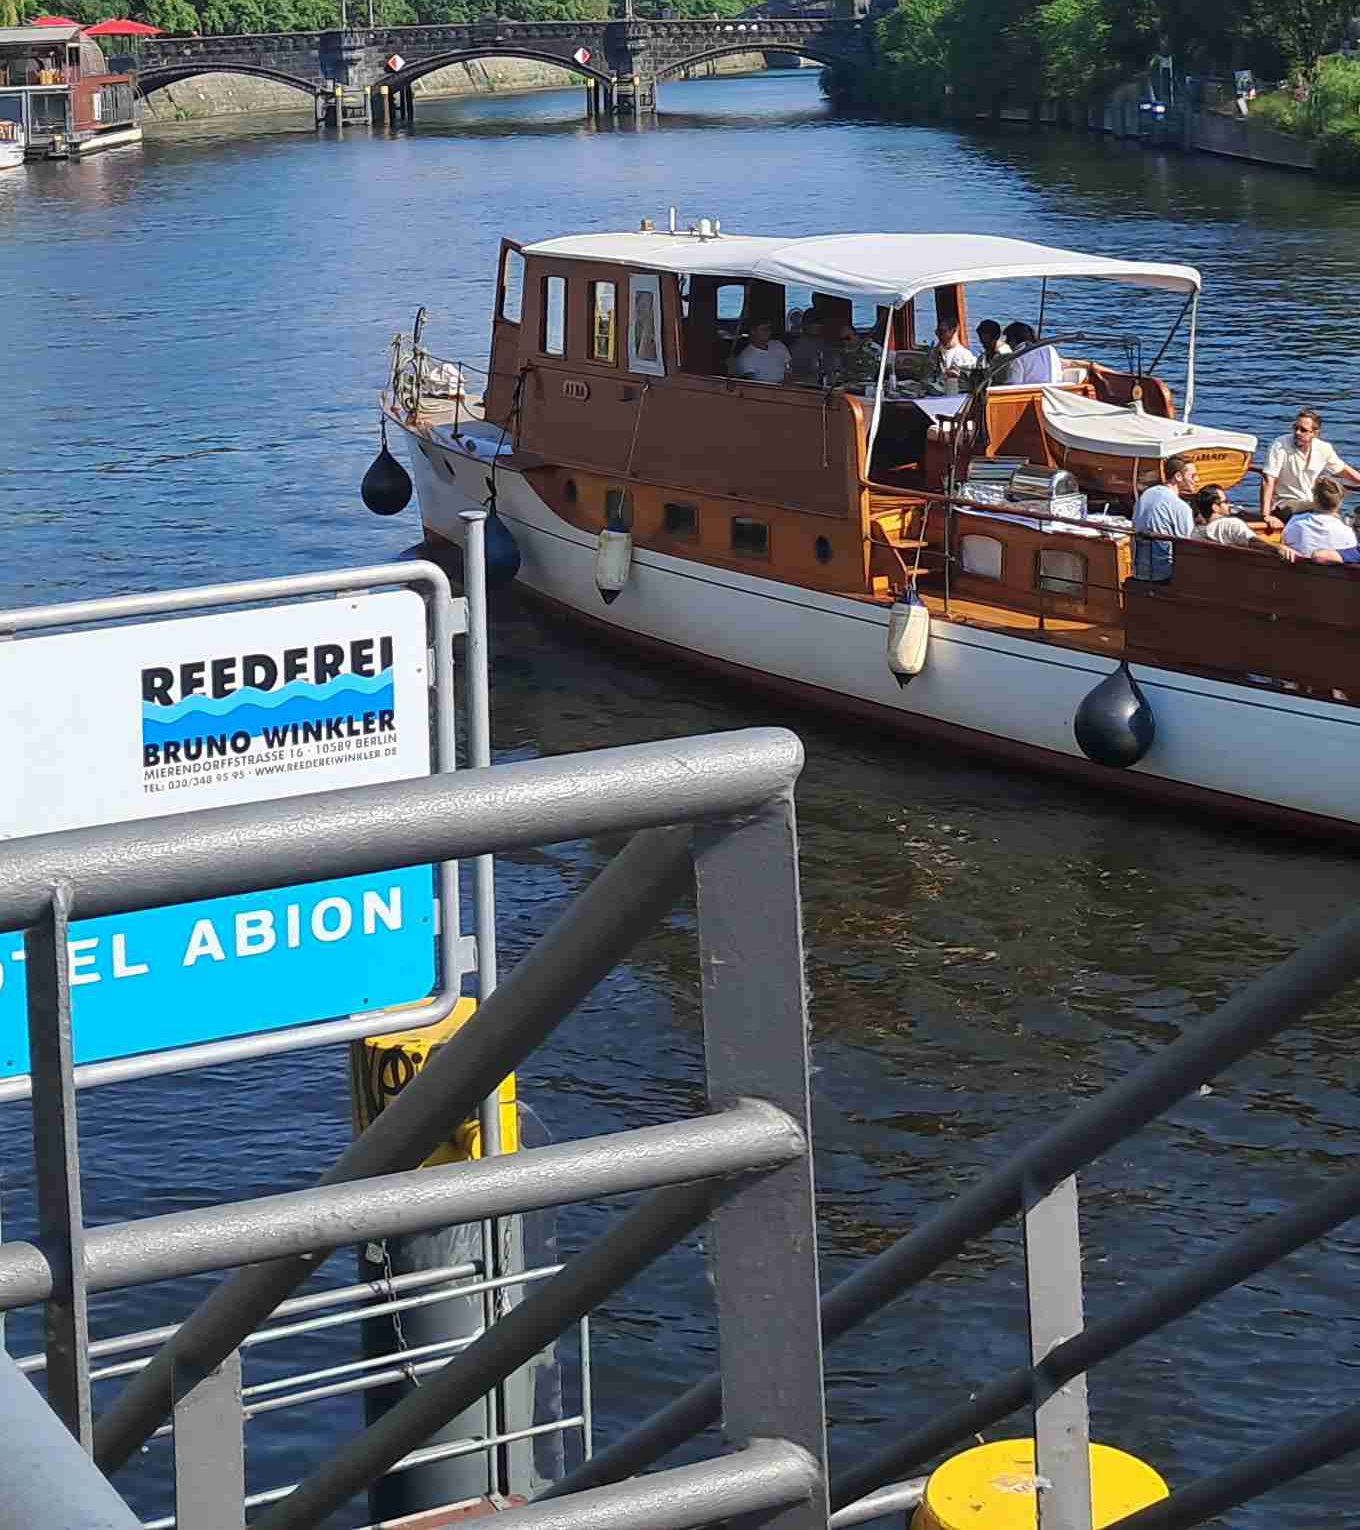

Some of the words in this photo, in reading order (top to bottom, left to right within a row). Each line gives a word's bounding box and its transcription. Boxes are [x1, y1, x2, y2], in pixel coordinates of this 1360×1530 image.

[141, 635, 394, 706] REEDEREI
[143, 730, 252, 768] BRUNO
[262, 709, 395, 749] WINKLER
[143, 749, 285, 781] MIERENDORFFSTRASSE
[289, 746, 304, 759] 16
[316, 740, 352, 756] 10589
[355, 733, 397, 750] BERLIN
[182, 886, 403, 967] ABION
